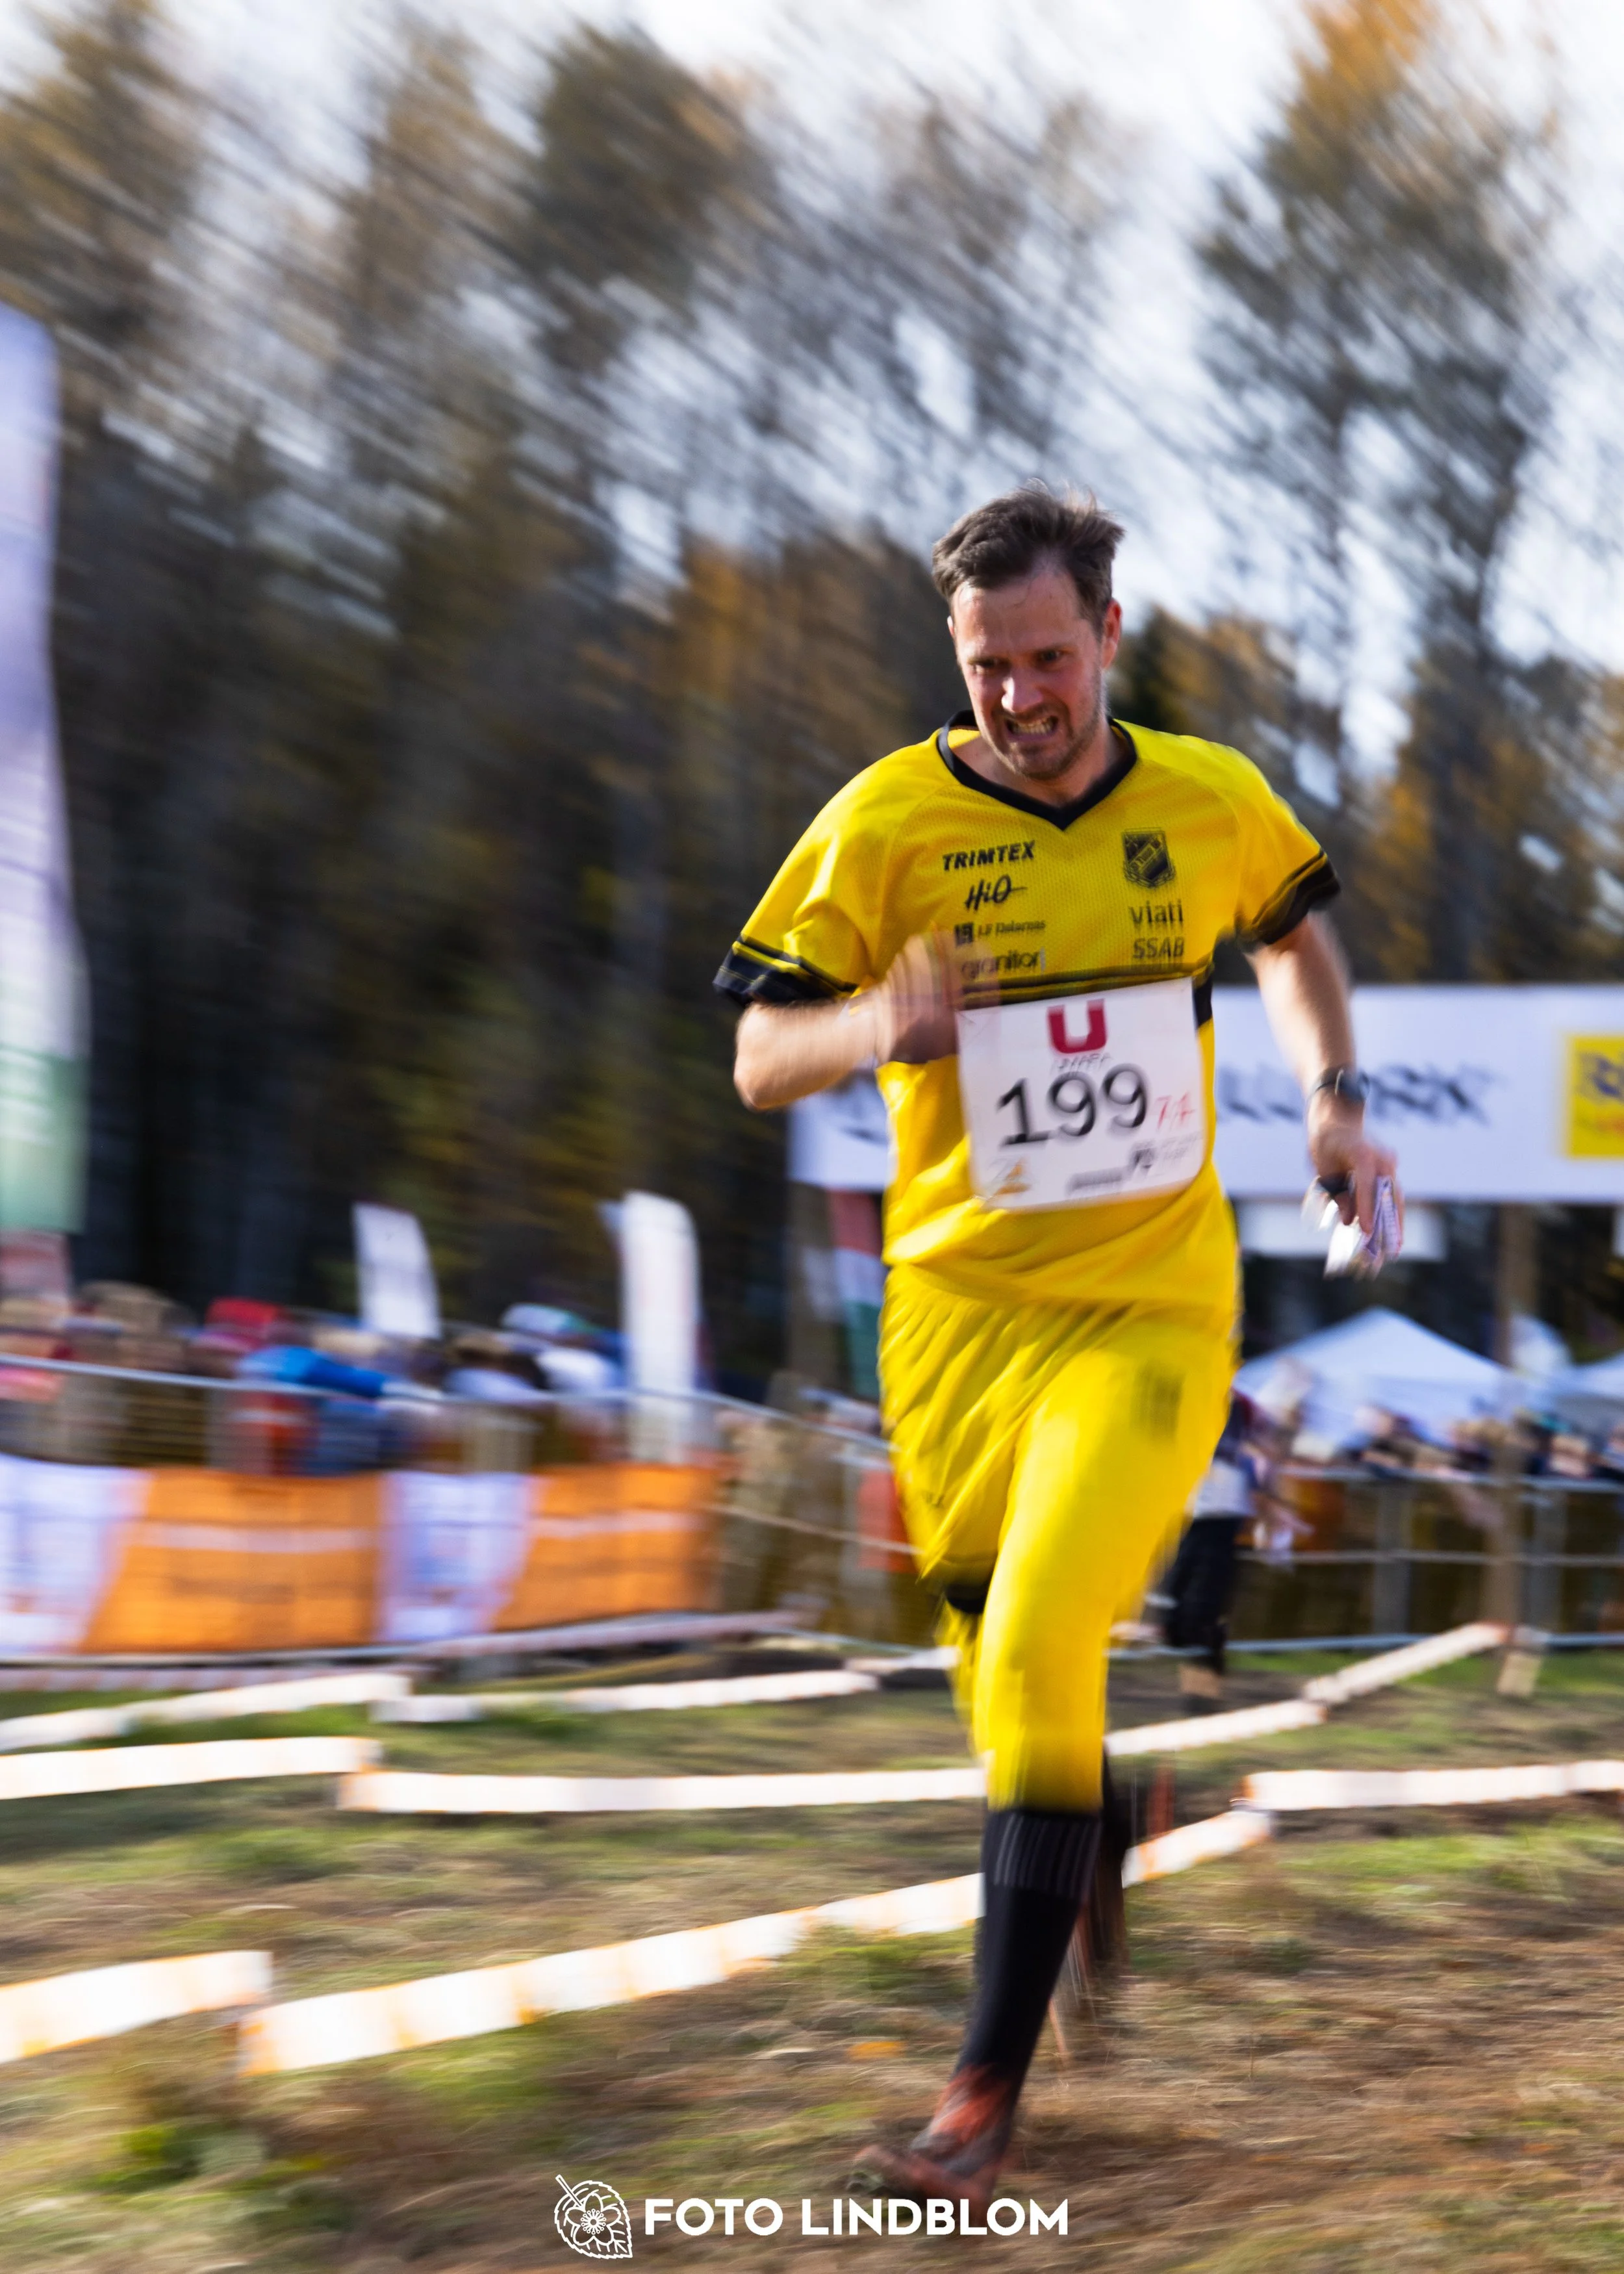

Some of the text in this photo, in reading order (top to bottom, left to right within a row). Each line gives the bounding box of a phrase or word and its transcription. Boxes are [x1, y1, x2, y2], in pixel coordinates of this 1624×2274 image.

[943, 839, 1035, 871] TRIMTEX
[1132, 937, 1185, 959] SSAB
[997, 1064, 1148, 1147] 199
